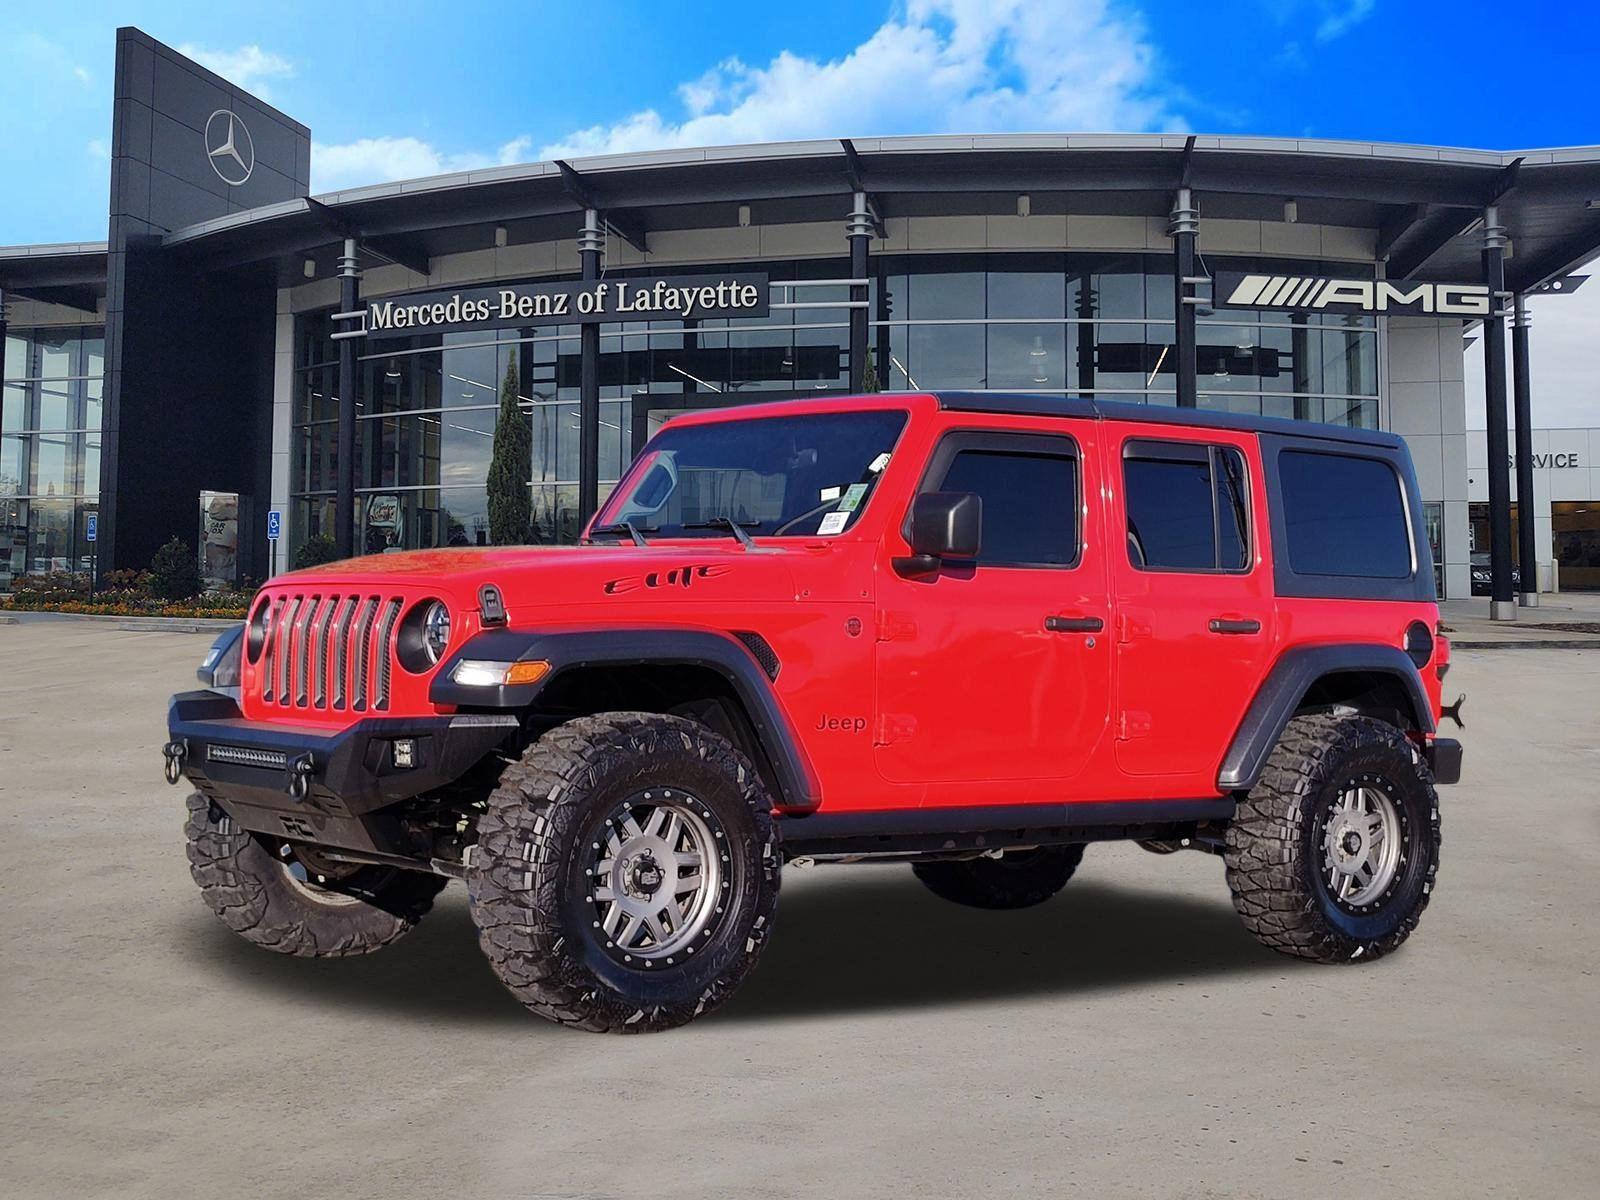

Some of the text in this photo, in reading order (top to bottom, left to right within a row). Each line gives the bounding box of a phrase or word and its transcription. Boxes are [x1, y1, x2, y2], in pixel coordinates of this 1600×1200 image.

[369, 279, 759, 331] Mercedes-Benz of Lafayette
[1312, 279, 1489, 315] AMG
[1507, 453, 1578, 468] SRVICE
[815, 714, 867, 734] Jeep
